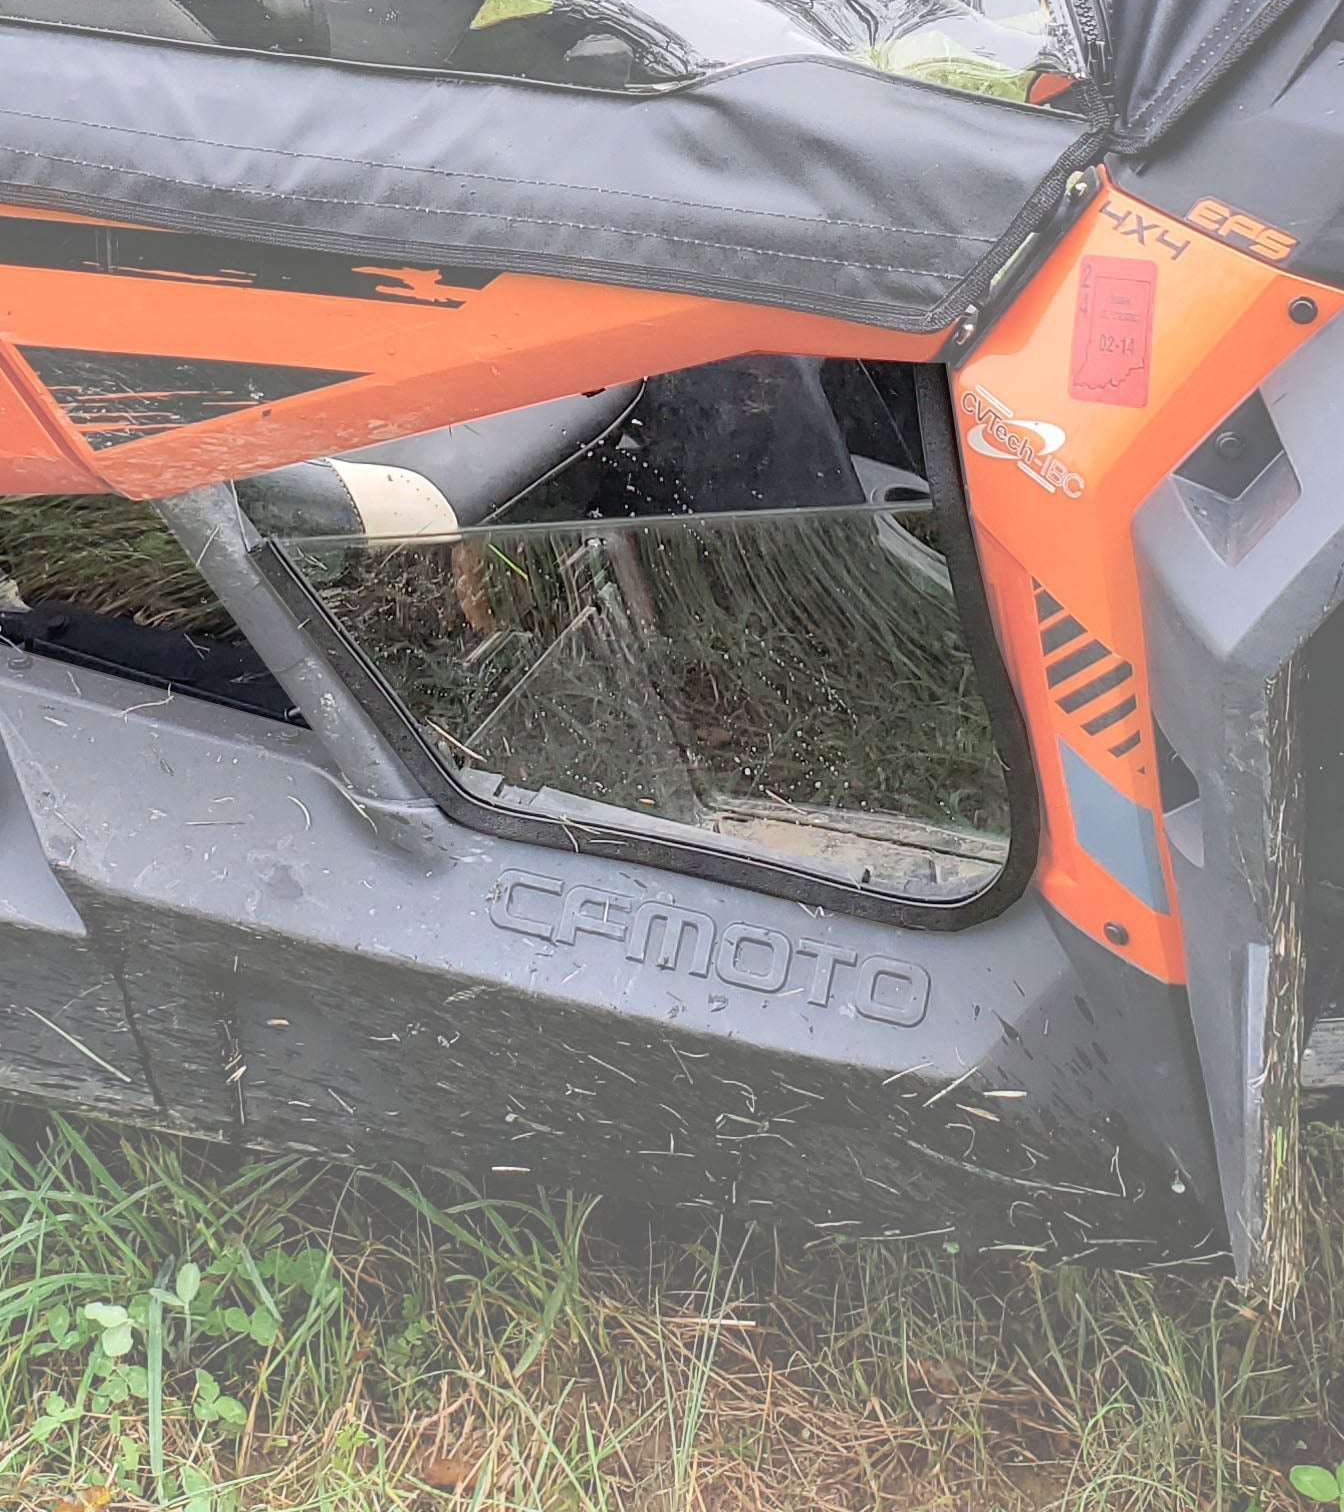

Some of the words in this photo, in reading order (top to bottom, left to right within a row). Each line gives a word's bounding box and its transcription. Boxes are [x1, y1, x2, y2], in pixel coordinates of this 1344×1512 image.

[1185, 196, 1300, 262] EPS
[1099, 334, 1136, 355] 02-14
[960, 391, 1085, 499] CVTech-IBC
[488, 867, 932, 1028] CFMOTO
